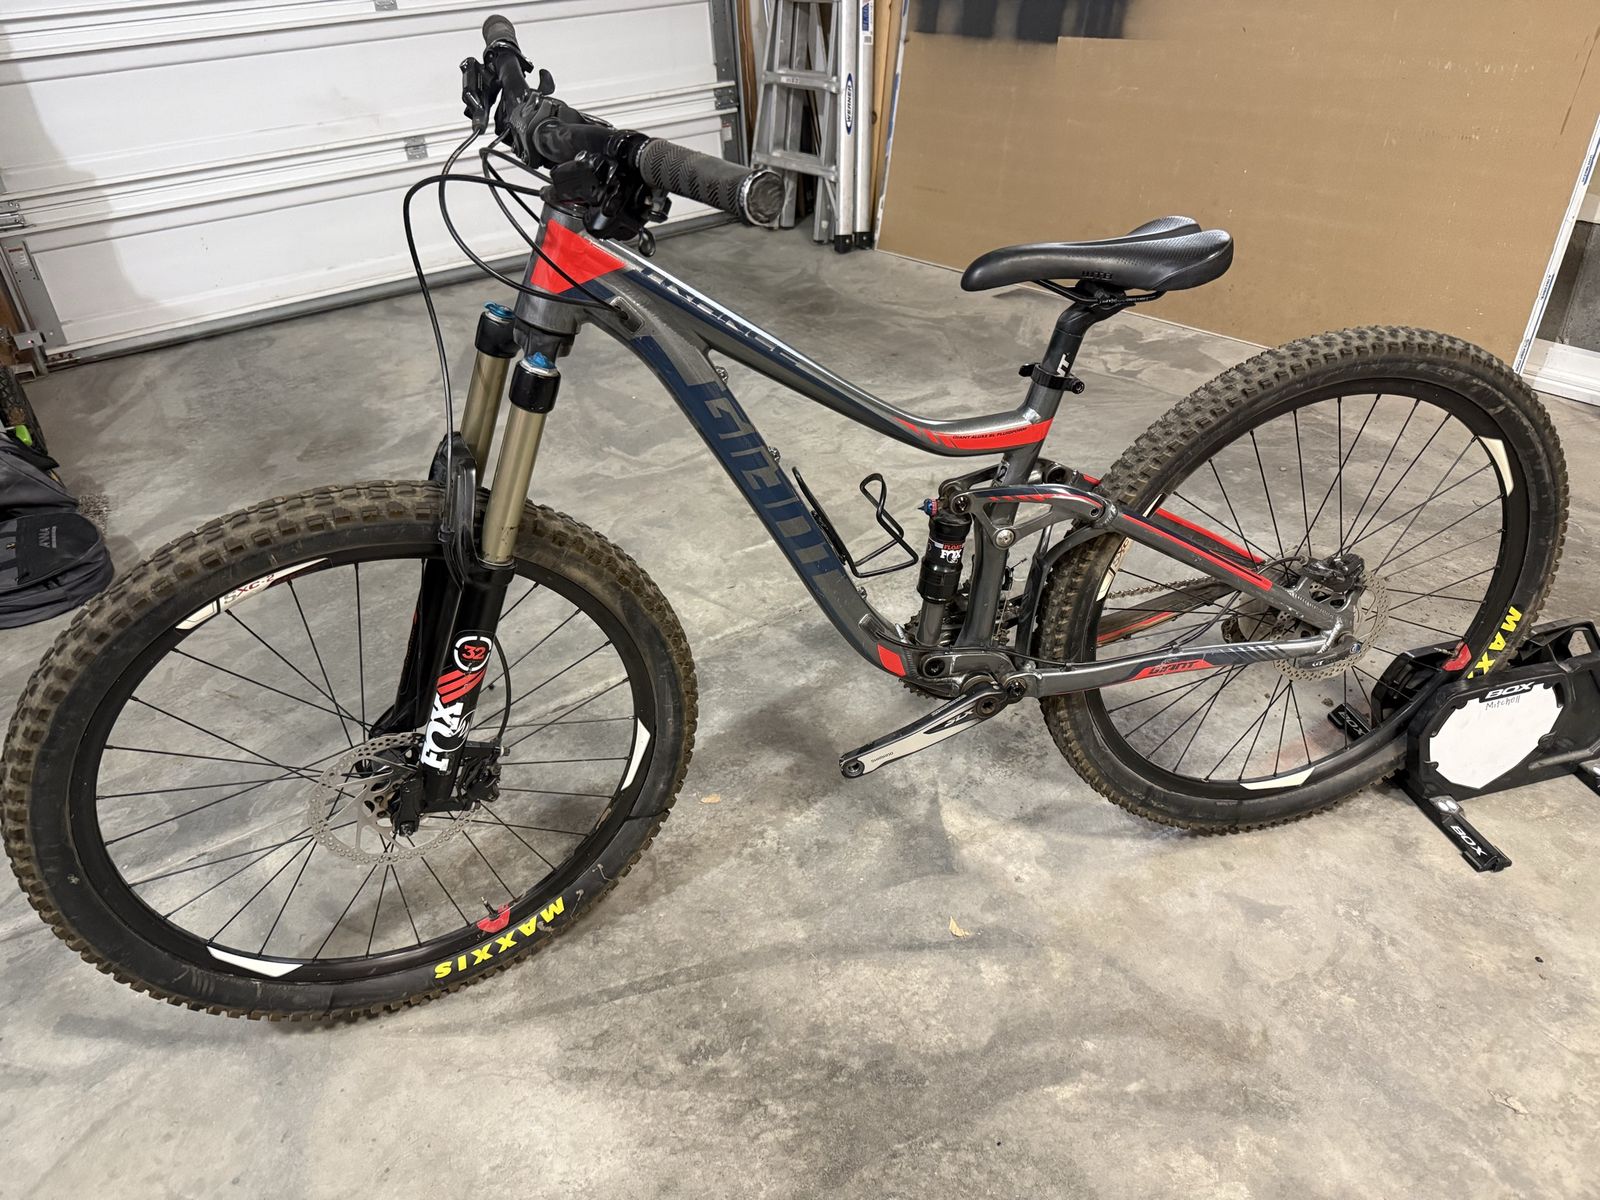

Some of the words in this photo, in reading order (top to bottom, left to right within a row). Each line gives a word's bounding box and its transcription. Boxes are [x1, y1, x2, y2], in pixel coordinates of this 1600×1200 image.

[940, 549, 962, 563] FOX
[462, 644, 486, 660] 32
[1467, 606, 1522, 679] MAX
[1485, 682, 1535, 700] BOX
[420, 692, 471, 772] FOX
[1338, 711, 1367, 736] BOX
[1450, 825, 1488, 856] BOX
[434, 896, 565, 979] MAXXIS
